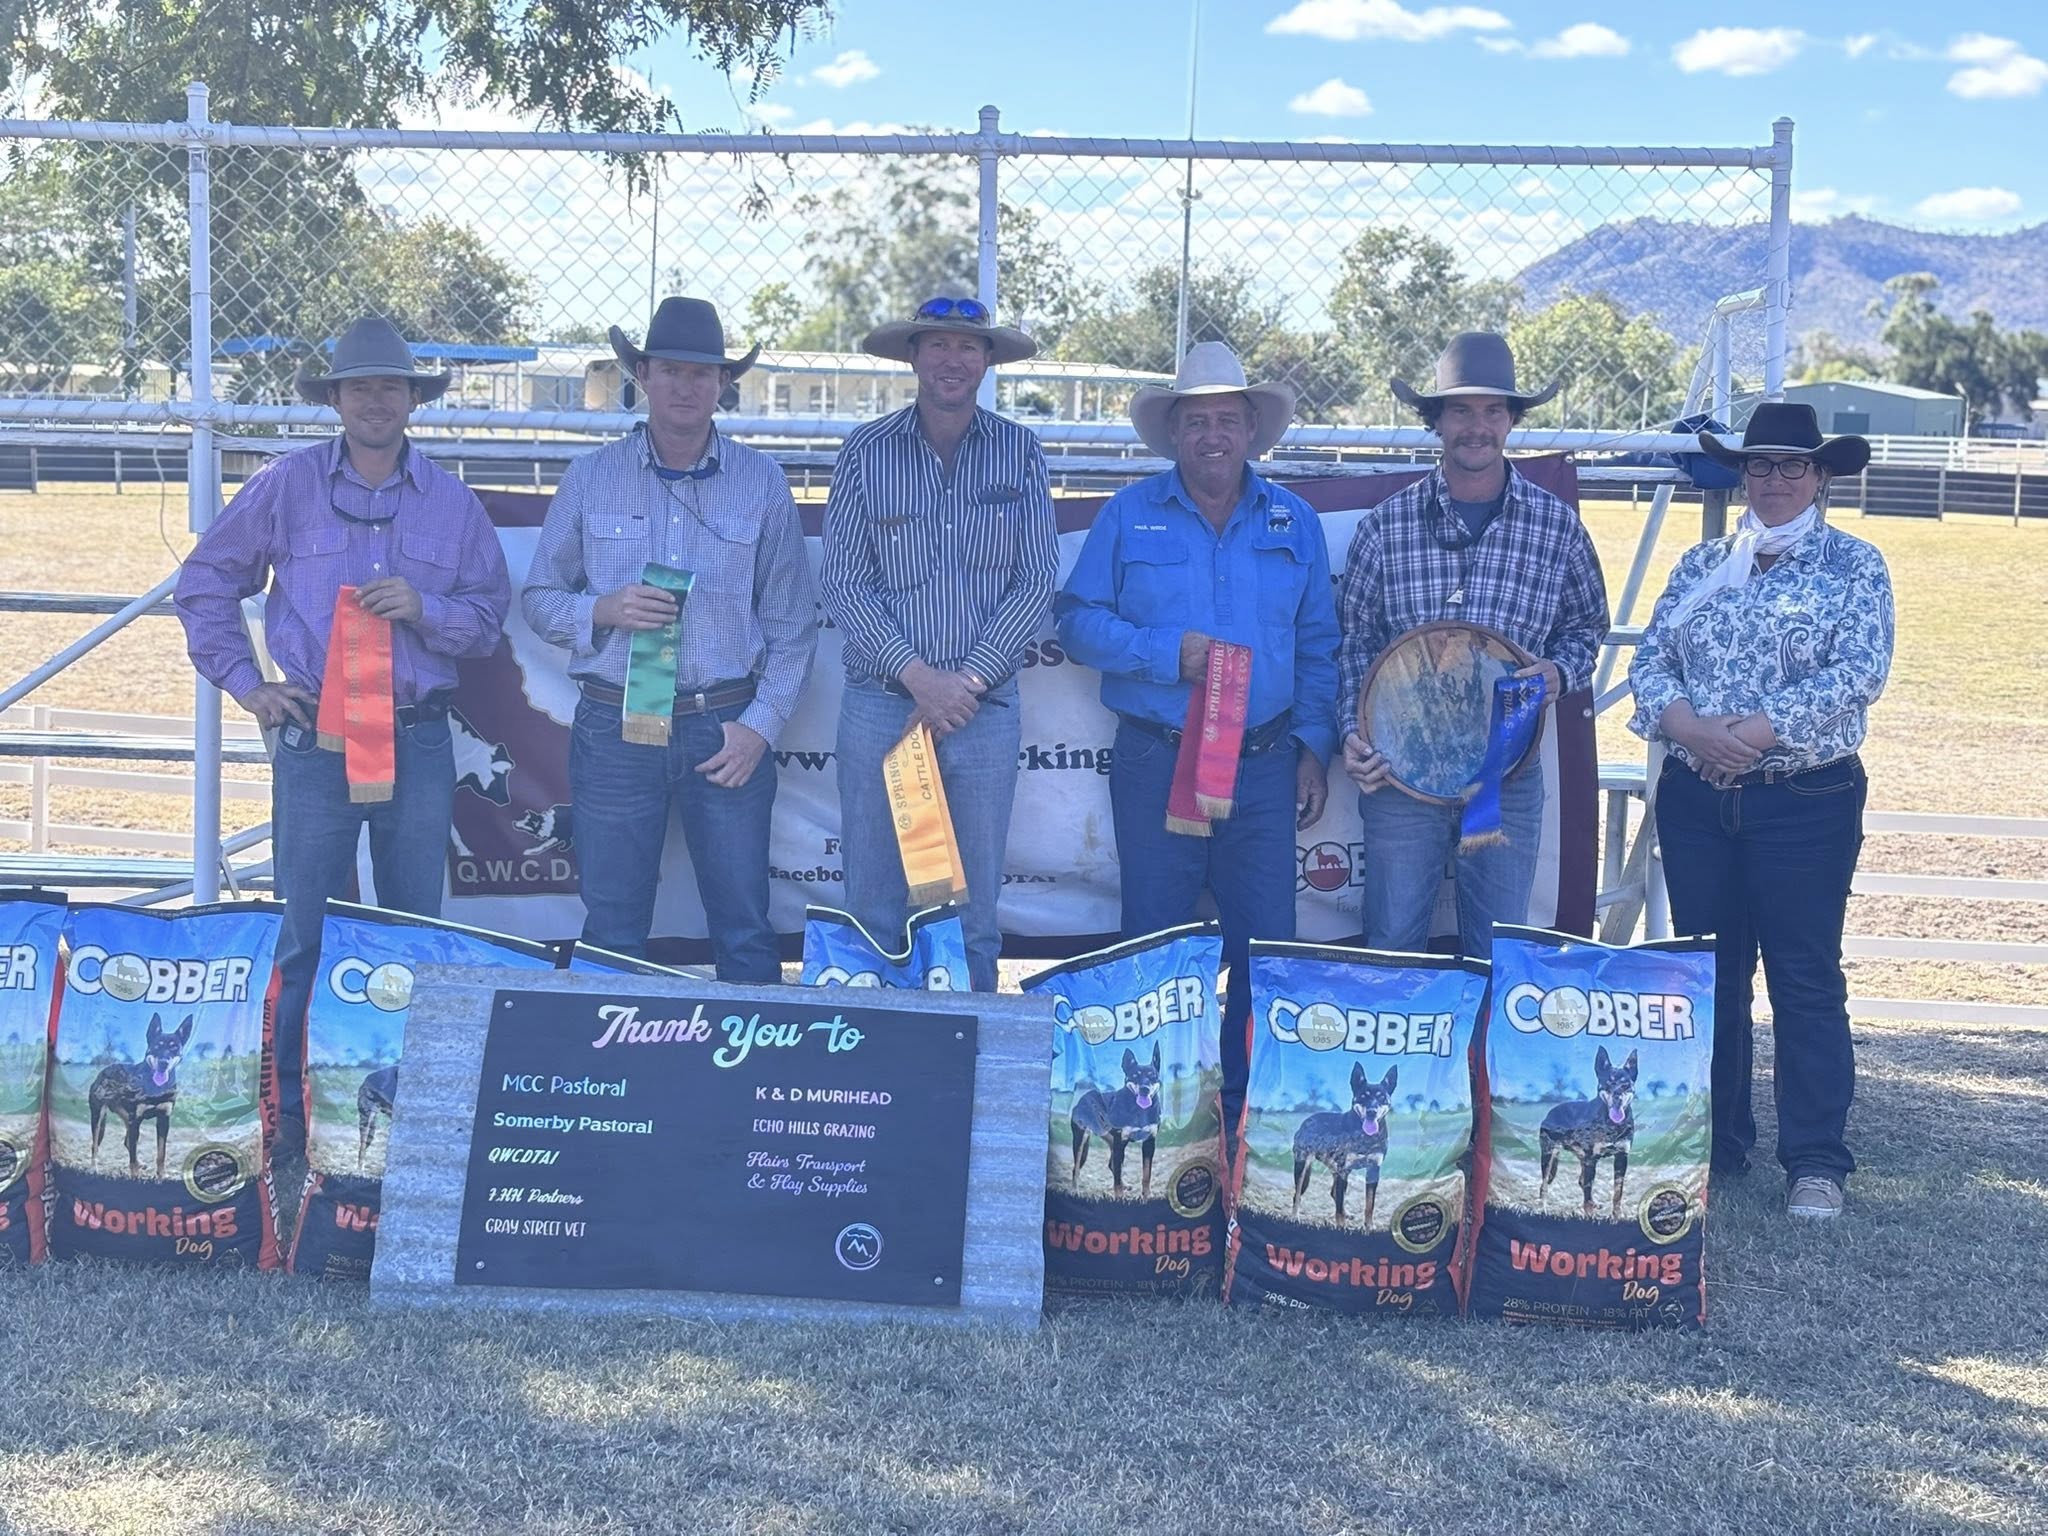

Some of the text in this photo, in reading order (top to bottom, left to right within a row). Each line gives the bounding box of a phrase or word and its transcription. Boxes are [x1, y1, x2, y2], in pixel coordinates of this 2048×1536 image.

[910, 730, 932, 801] CATTLE DO
[66, 944, 253, 1004] COBBER
[1053, 975, 1205, 1045] COBBER
[1504, 982, 1695, 1041] COBBER
[592, 1004, 865, 1068] Thank You to
[1267, 996, 1454, 1057] COBBER
[1312, 1035, 1332, 1044] 1985
[501, 1073, 627, 1096] MCC Pastoral
[755, 1086, 892, 1105] K & D MURIHEAD
[493, 1112, 654, 1134] Somerby Pastoral
[753, 1118, 876, 1139] ECHO HILLS GRAZING
[796, 1153, 866, 1176] Transport
[527, 1188, 585, 1205] Partners
[747, 1173, 868, 1198] & Hay Supplies
[73, 1197, 238, 1238] Working
[485, 1218, 586, 1237] GRAY STREET VET
[175, 1237, 213, 1260] Dog
[1047, 1220, 1212, 1256] Working
[1155, 1255, 1190, 1278] Dog
[1265, 1243, 1438, 1290] Working
[1510, 1239, 1683, 1285] Working
[1070, 1278, 1124, 1289] PROTEIN
[1623, 1280, 1660, 1307] Dog
[1376, 1288, 1413, 1311] Dog
[1503, 1296, 1530, 1311] 28%
[1533, 1302, 1589, 1316] PROTEIN
[1602, 1307, 1626, 1318] 18%
[1628, 1307, 1651, 1319] FAT
